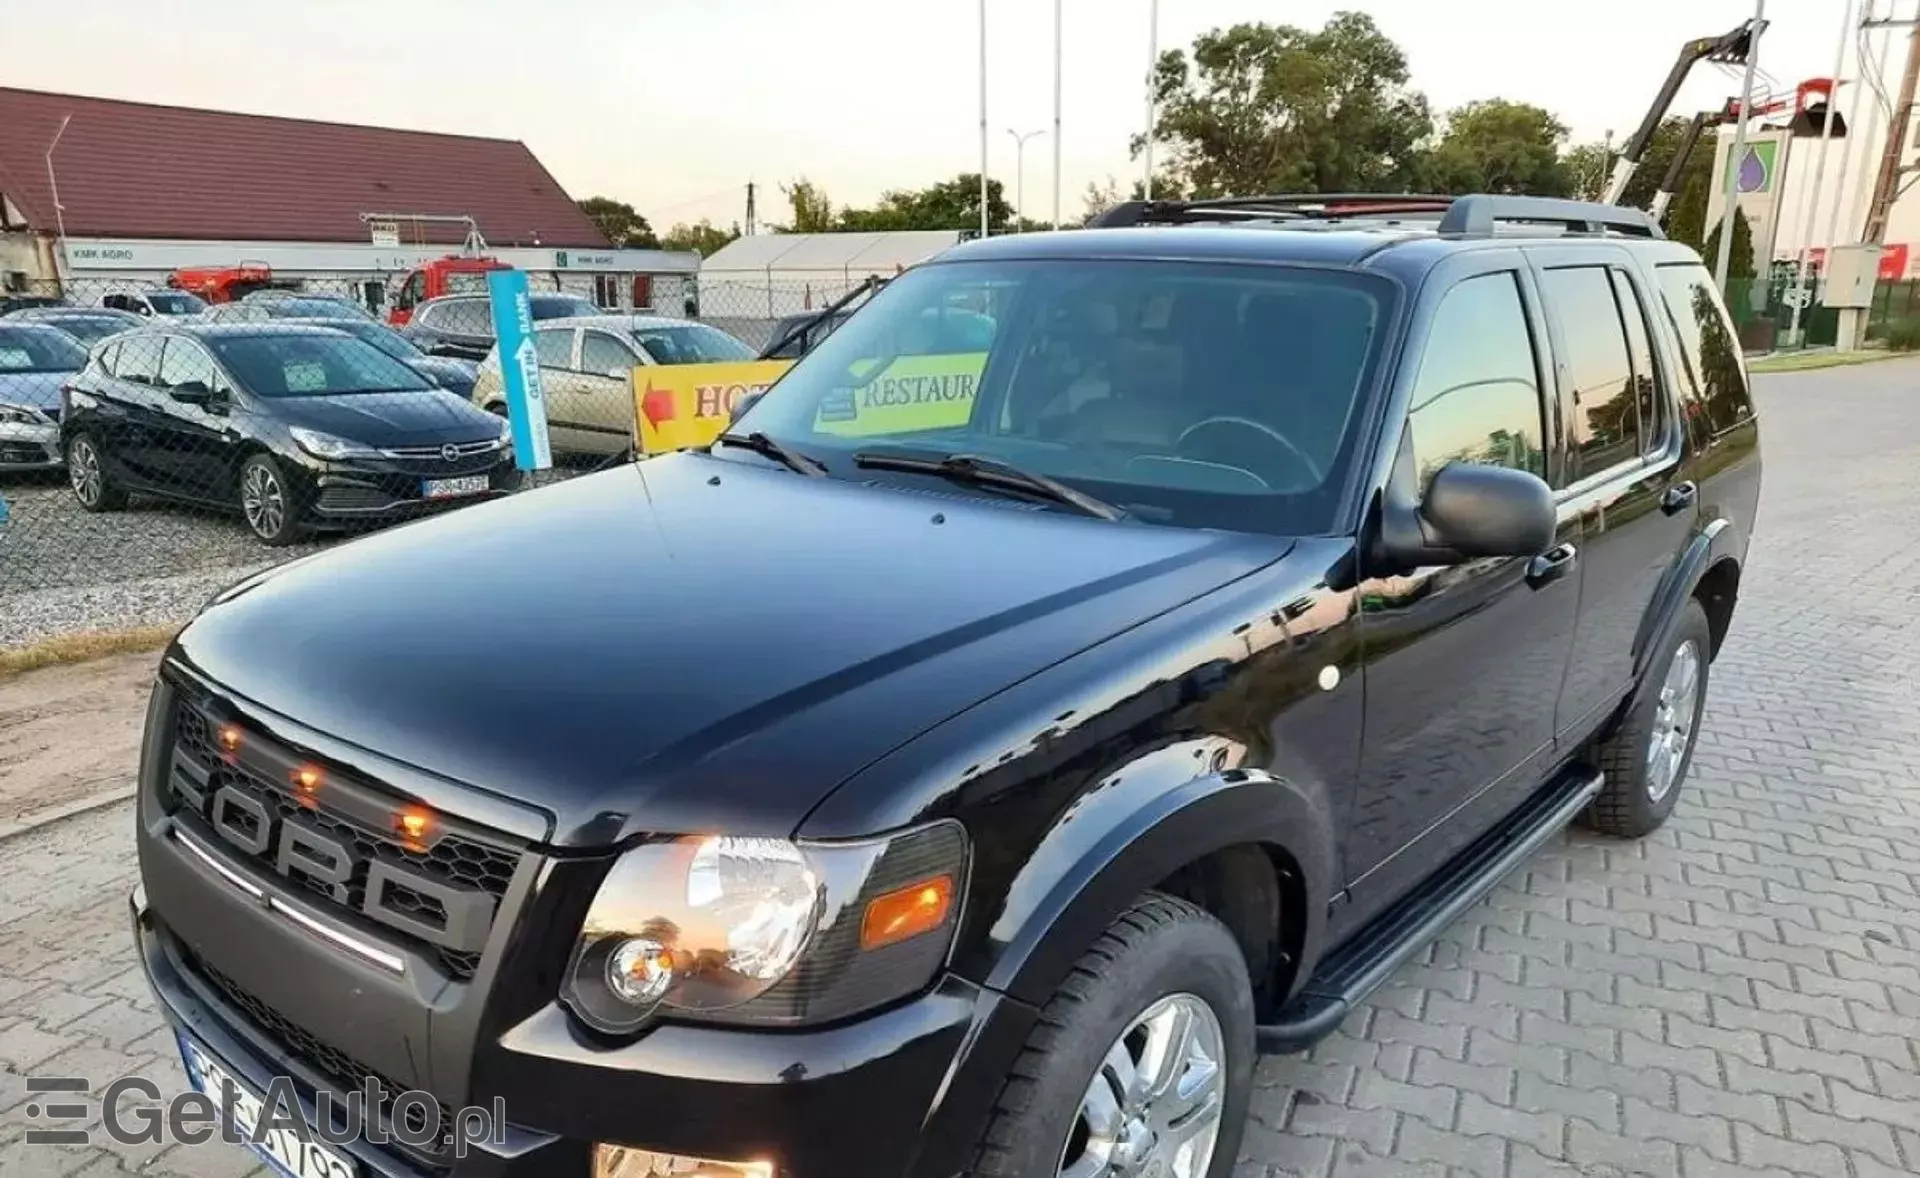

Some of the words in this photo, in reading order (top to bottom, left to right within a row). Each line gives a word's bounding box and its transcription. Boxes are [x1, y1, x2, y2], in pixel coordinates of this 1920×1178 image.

[101, 249, 134, 260] AGRO
[515, 292, 531, 334] BANK
[167, 745, 498, 952] FORD
